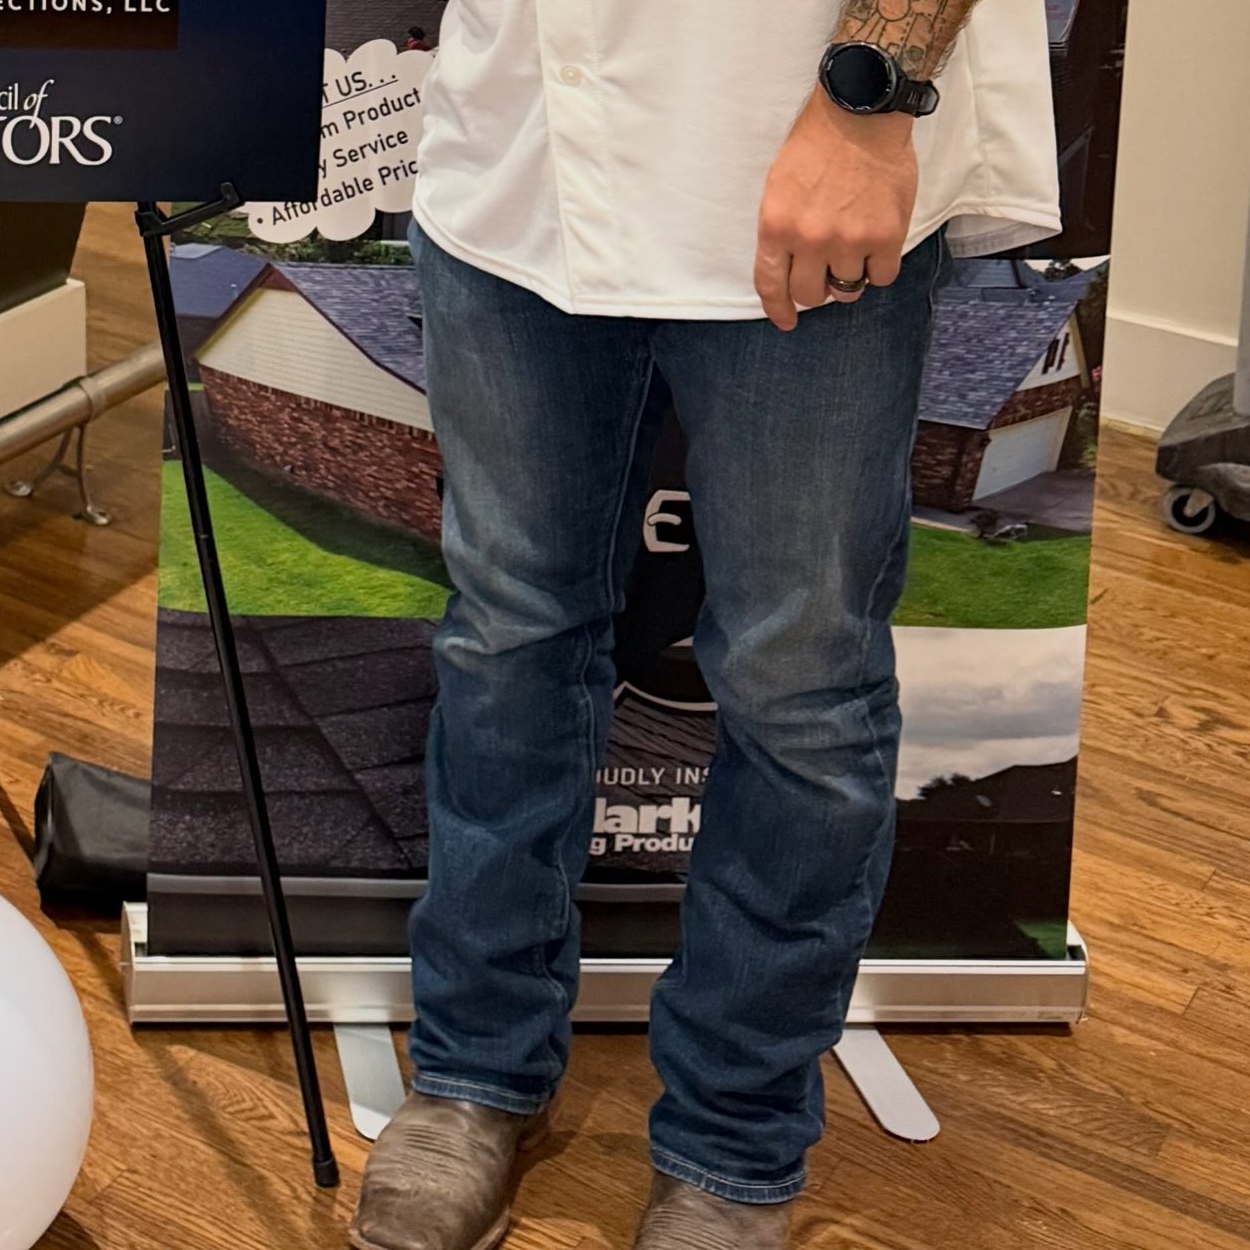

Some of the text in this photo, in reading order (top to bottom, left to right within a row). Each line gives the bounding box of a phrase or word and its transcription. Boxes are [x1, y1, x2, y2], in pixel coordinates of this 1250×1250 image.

[23, 79, 55, 130] of
[333, 130, 409, 168] Service
[272, 159, 419, 226] Affordable Pric
[596, 767, 666, 785] UDLY
[614, 834, 694, 852] Produ
